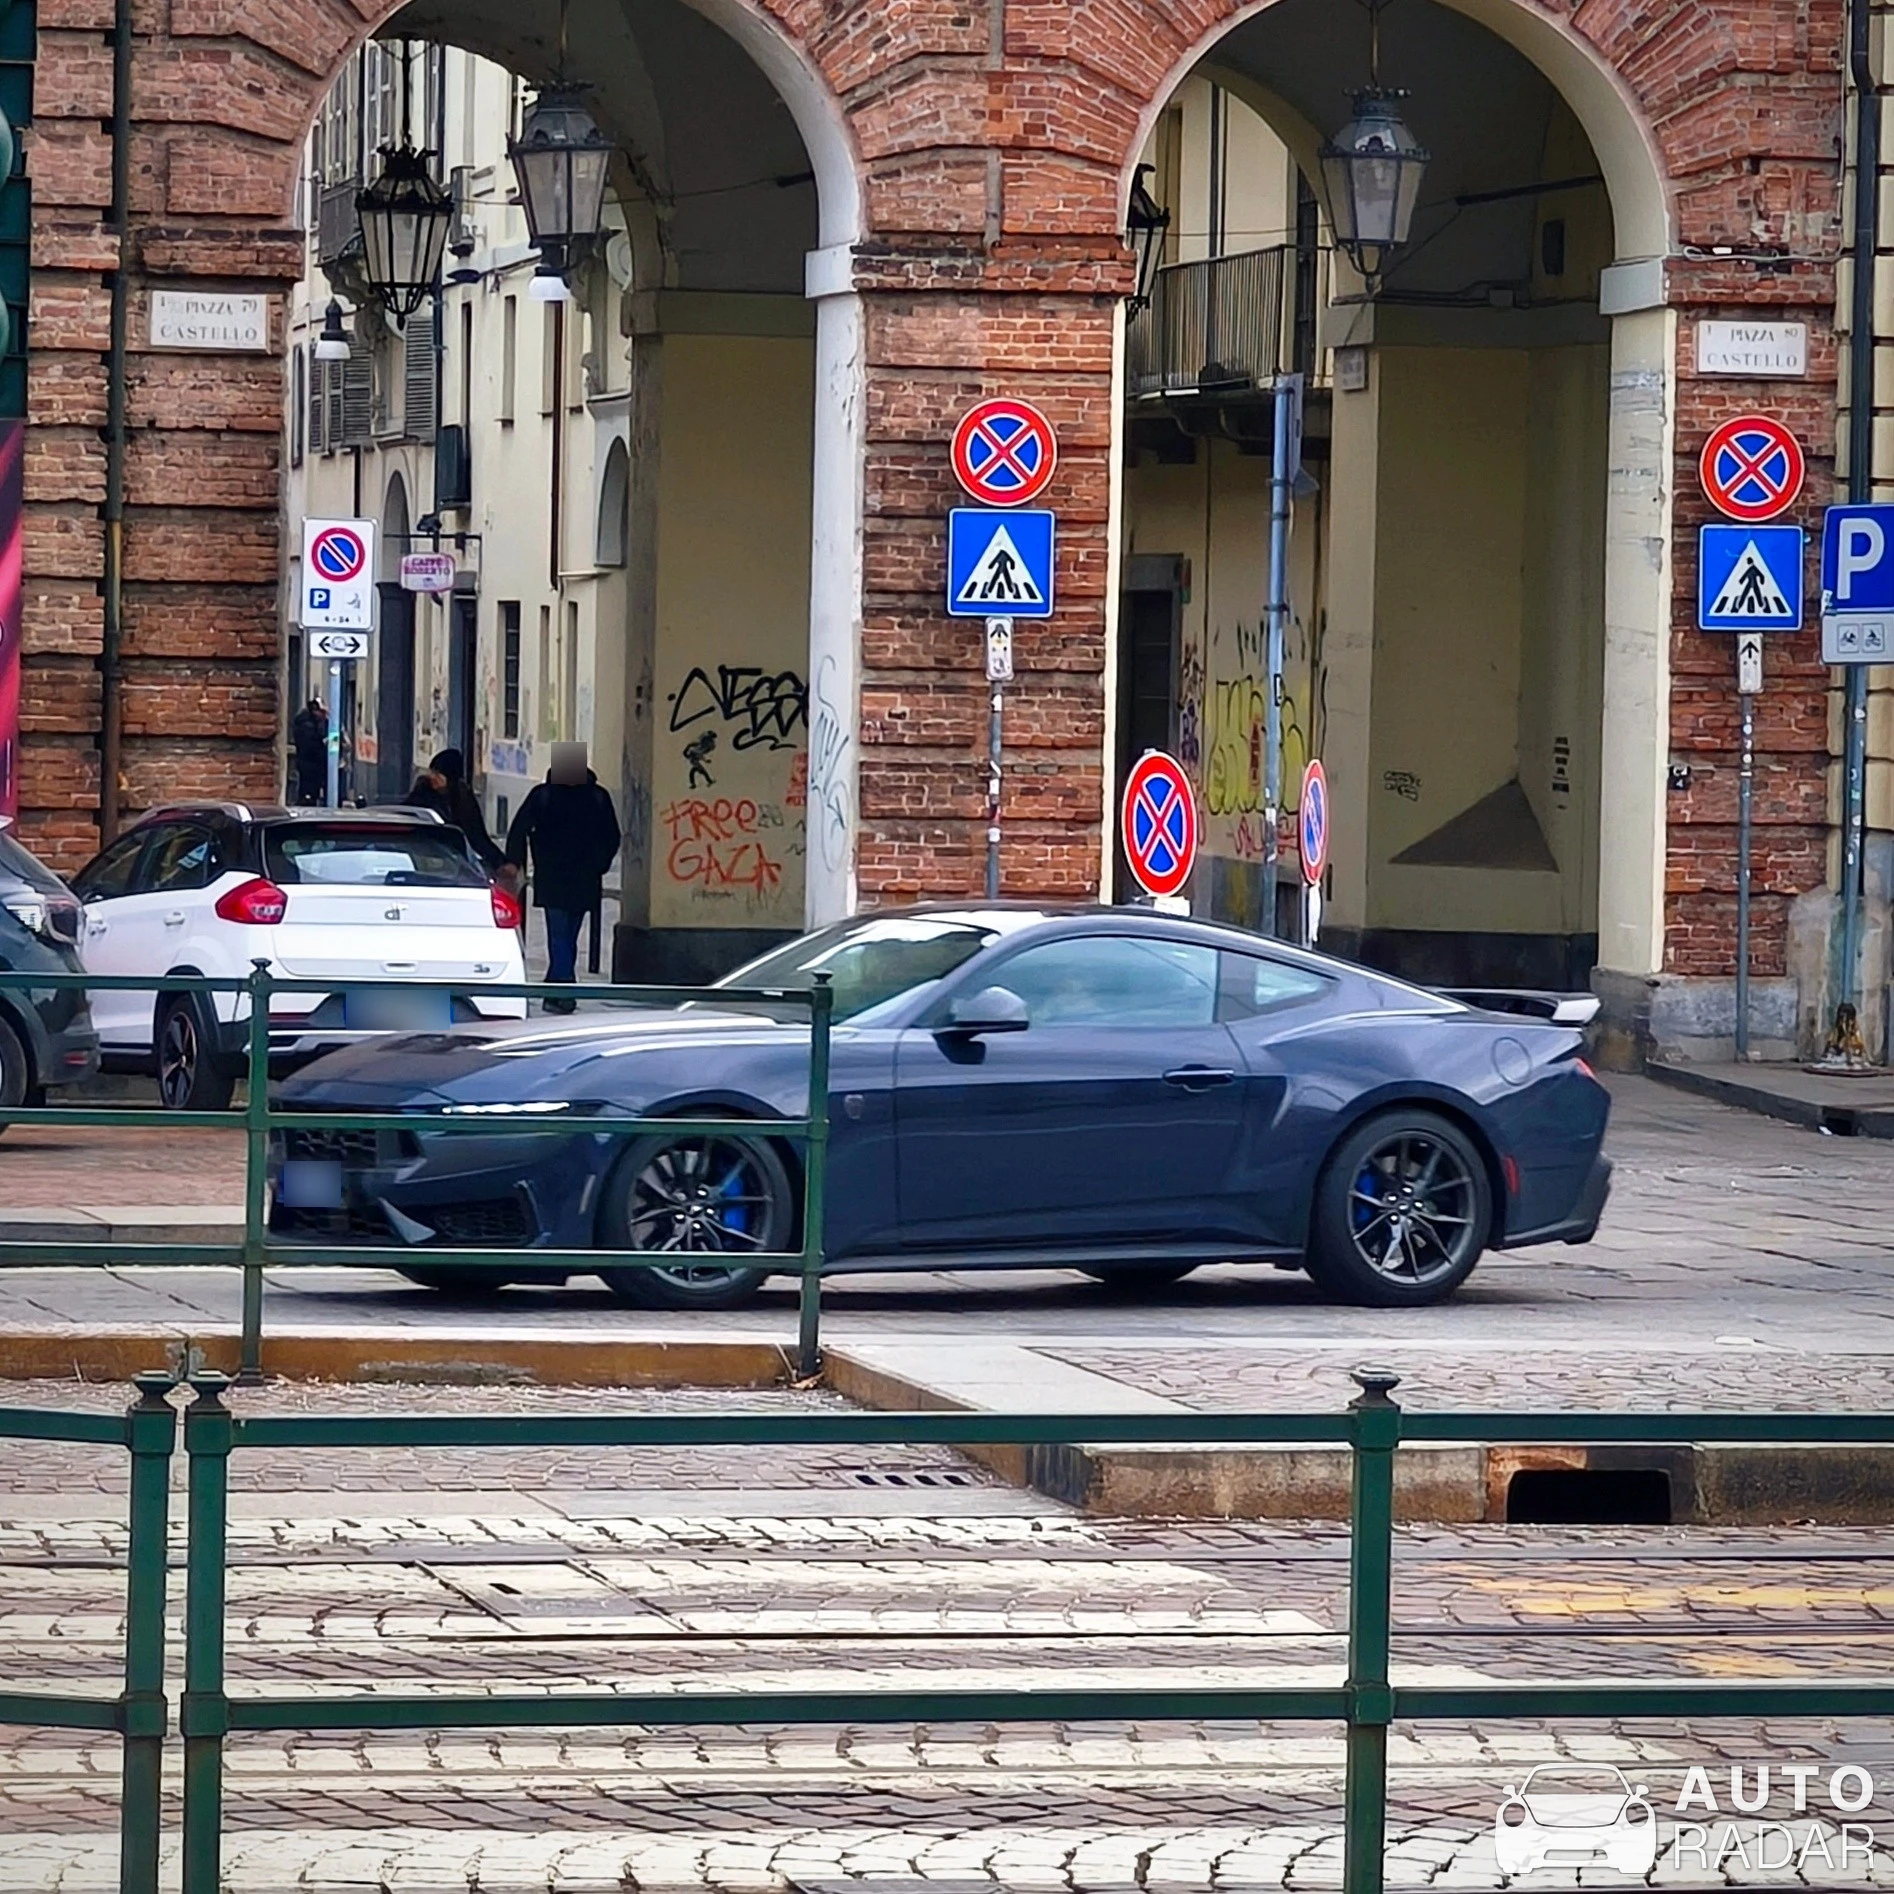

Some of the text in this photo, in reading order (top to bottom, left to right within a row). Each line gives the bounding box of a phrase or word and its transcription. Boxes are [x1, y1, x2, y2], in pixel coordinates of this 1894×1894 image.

[186, 301, 233, 315] PIAZZA
[160, 324, 258, 340] CASTELLO
[1731, 329, 1775, 342] PIAZZA
[1707, 353, 1798, 367] CASTELLO
[1837, 517, 1885, 600] P
[313, 590, 328, 607] P
[667, 838, 781, 898] GAZA
